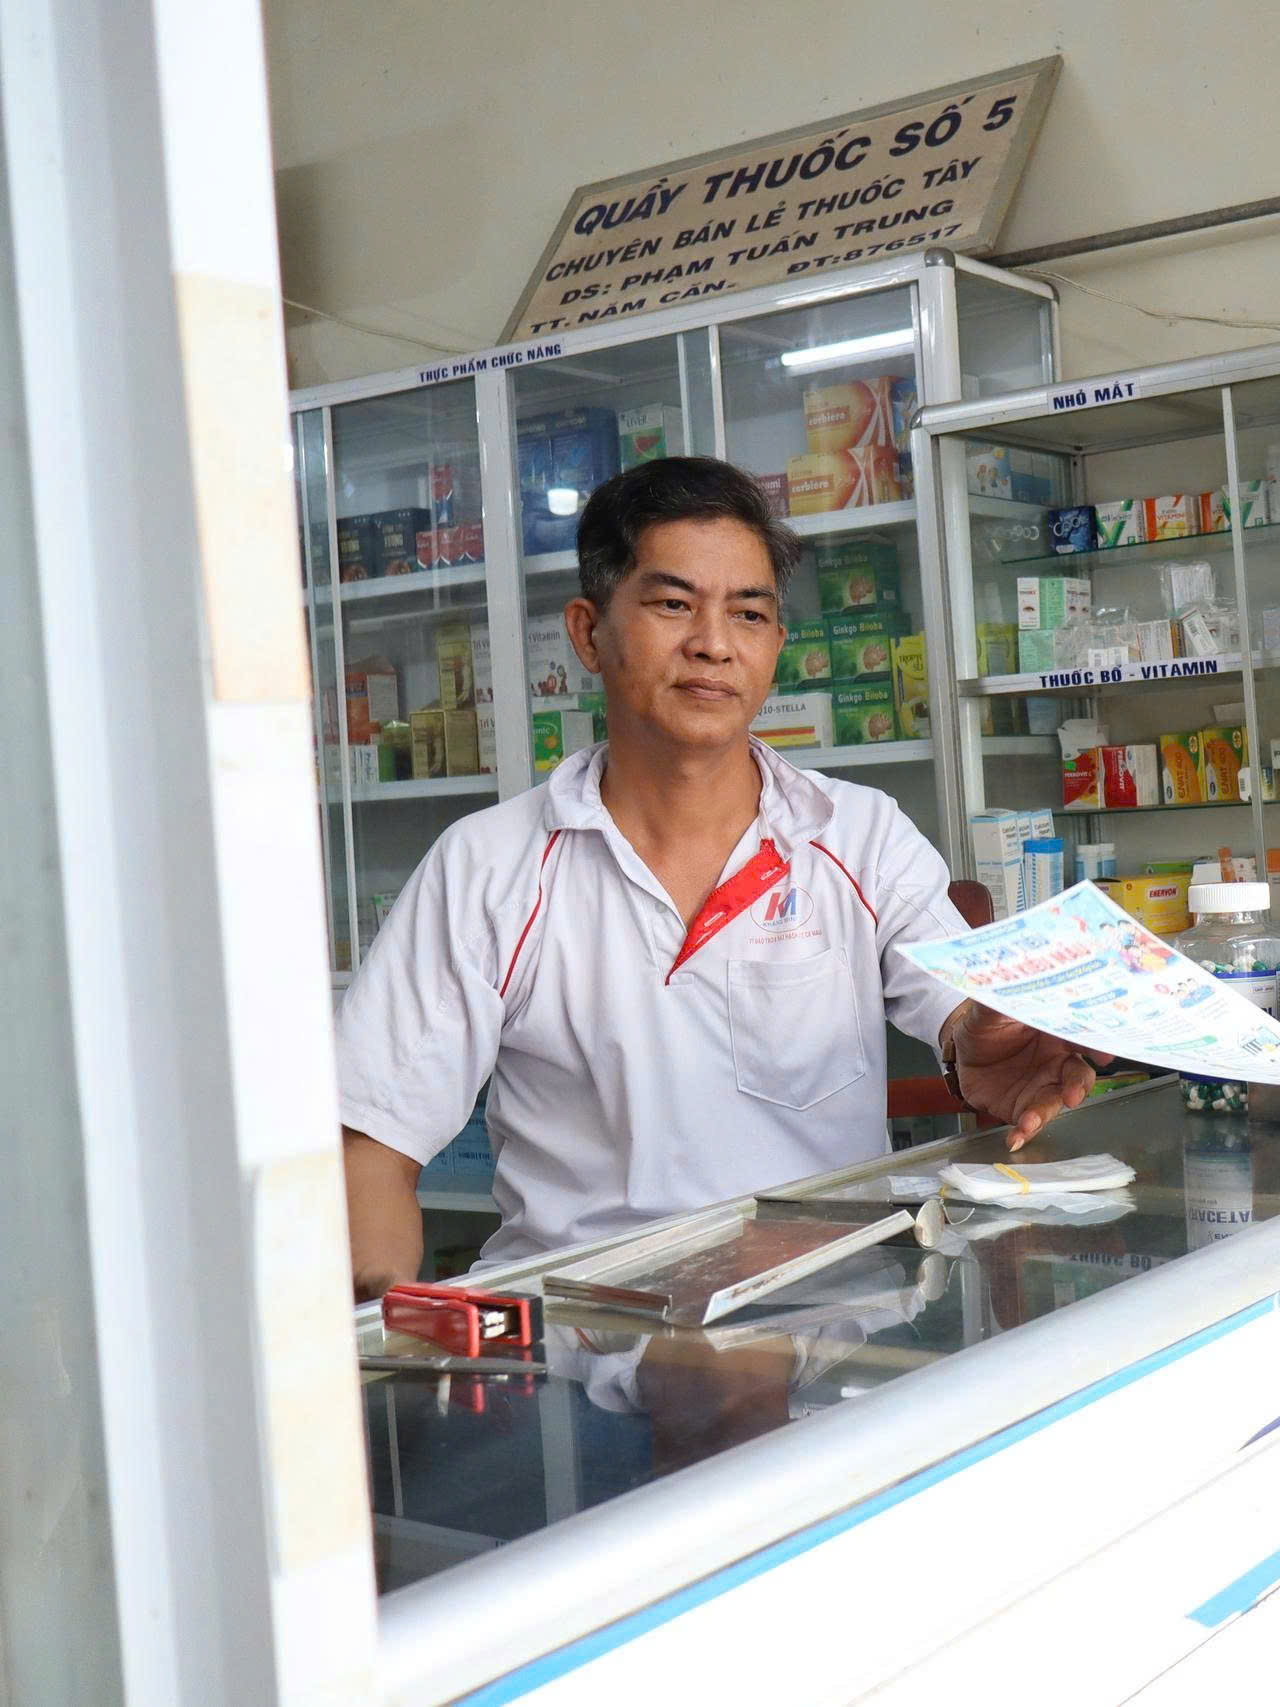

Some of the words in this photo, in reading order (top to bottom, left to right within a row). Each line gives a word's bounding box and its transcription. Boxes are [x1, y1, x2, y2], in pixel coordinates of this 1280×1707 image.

[702, 129, 871, 204] THUỐC
[889, 96, 976, 157] SỐ
[982, 96, 1017, 132] 5
[546, 237, 663, 282] CHUYÊN
[673, 219, 736, 250] BÁN
[746, 201, 785, 233] LẺ
[798, 174, 905, 220] THUỐC
[923, 157, 982, 190] TÂY
[560, 284, 611, 306] DS:
[620, 257, 714, 284] PHẠM
[728, 231, 818, 266] TUẤN
[834, 199, 954, 240] TRUNG
[531, 317, 570, 334] TT.
[578, 298, 646, 324] NĂM
[420, 368, 448, 383] THỰC
[1039, 668, 1093, 688] THUỐC
[1141, 660, 1218, 679] VITAMIN
